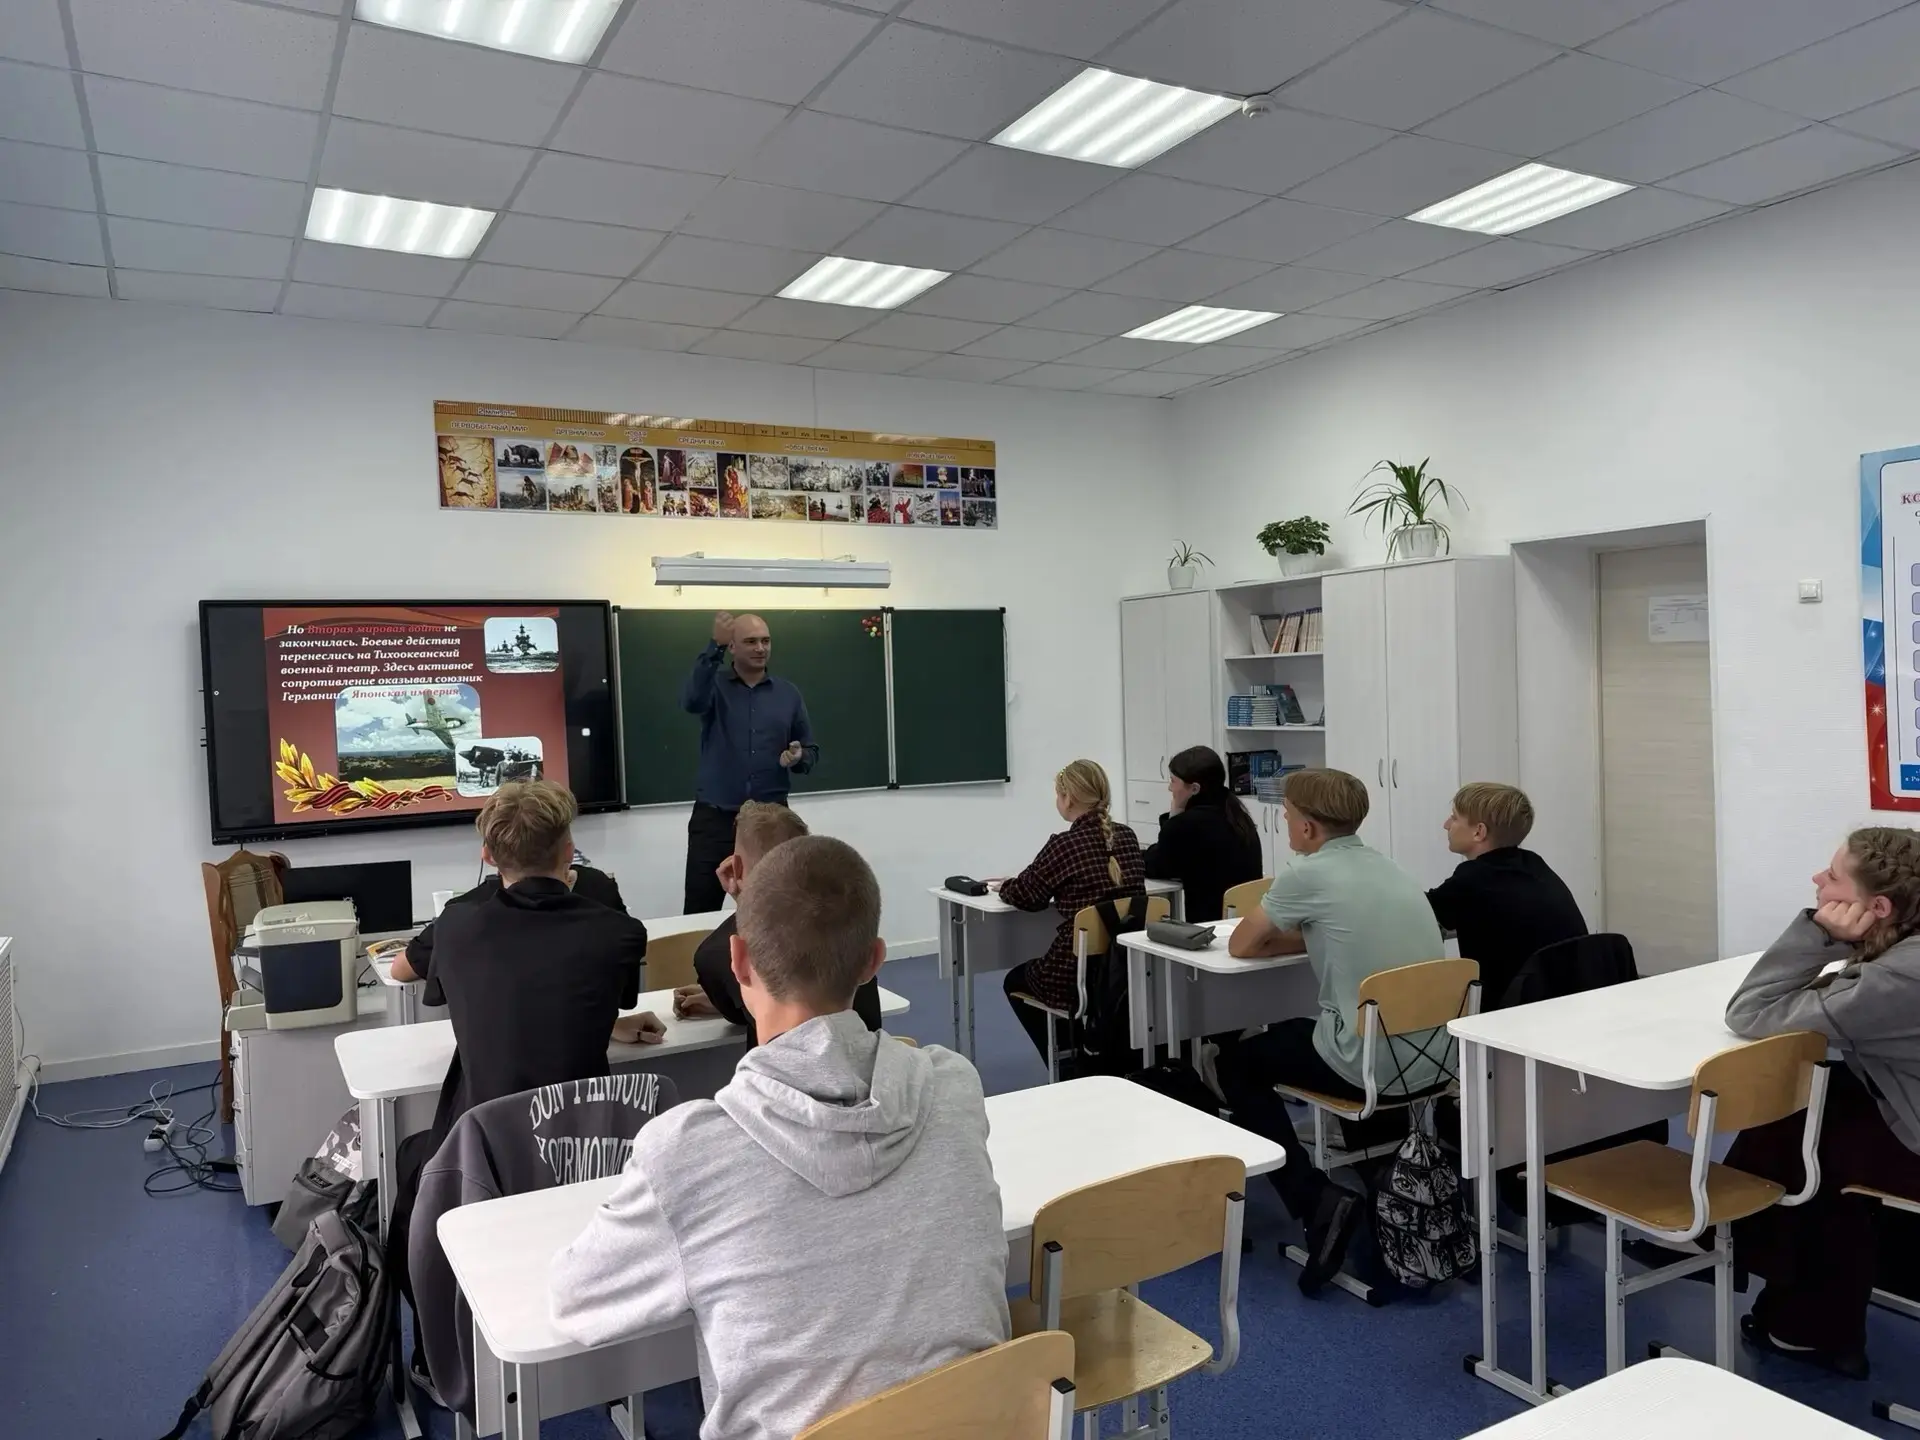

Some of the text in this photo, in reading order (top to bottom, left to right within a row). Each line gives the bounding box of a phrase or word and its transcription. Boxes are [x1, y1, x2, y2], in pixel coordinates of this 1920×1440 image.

[452, 422, 508, 431] ПЕРВОБЫТНЫЙ
[287, 625, 304, 634] Но
[307, 625, 353, 636] Вторая
[356, 626, 405, 636] мировая
[408, 624, 441, 633] война
[279, 636, 460, 648] закончилась. Боевые действия
[280, 649, 460, 663] перенеслись на Тихоокеанский
[280, 665, 333, 675] военный
[336, 665, 380, 674] театр.
[383, 662, 415, 672] Здесь
[281, 675, 483, 690] сопротивление оказывал союзник
[351, 688, 407, 699] Японская
